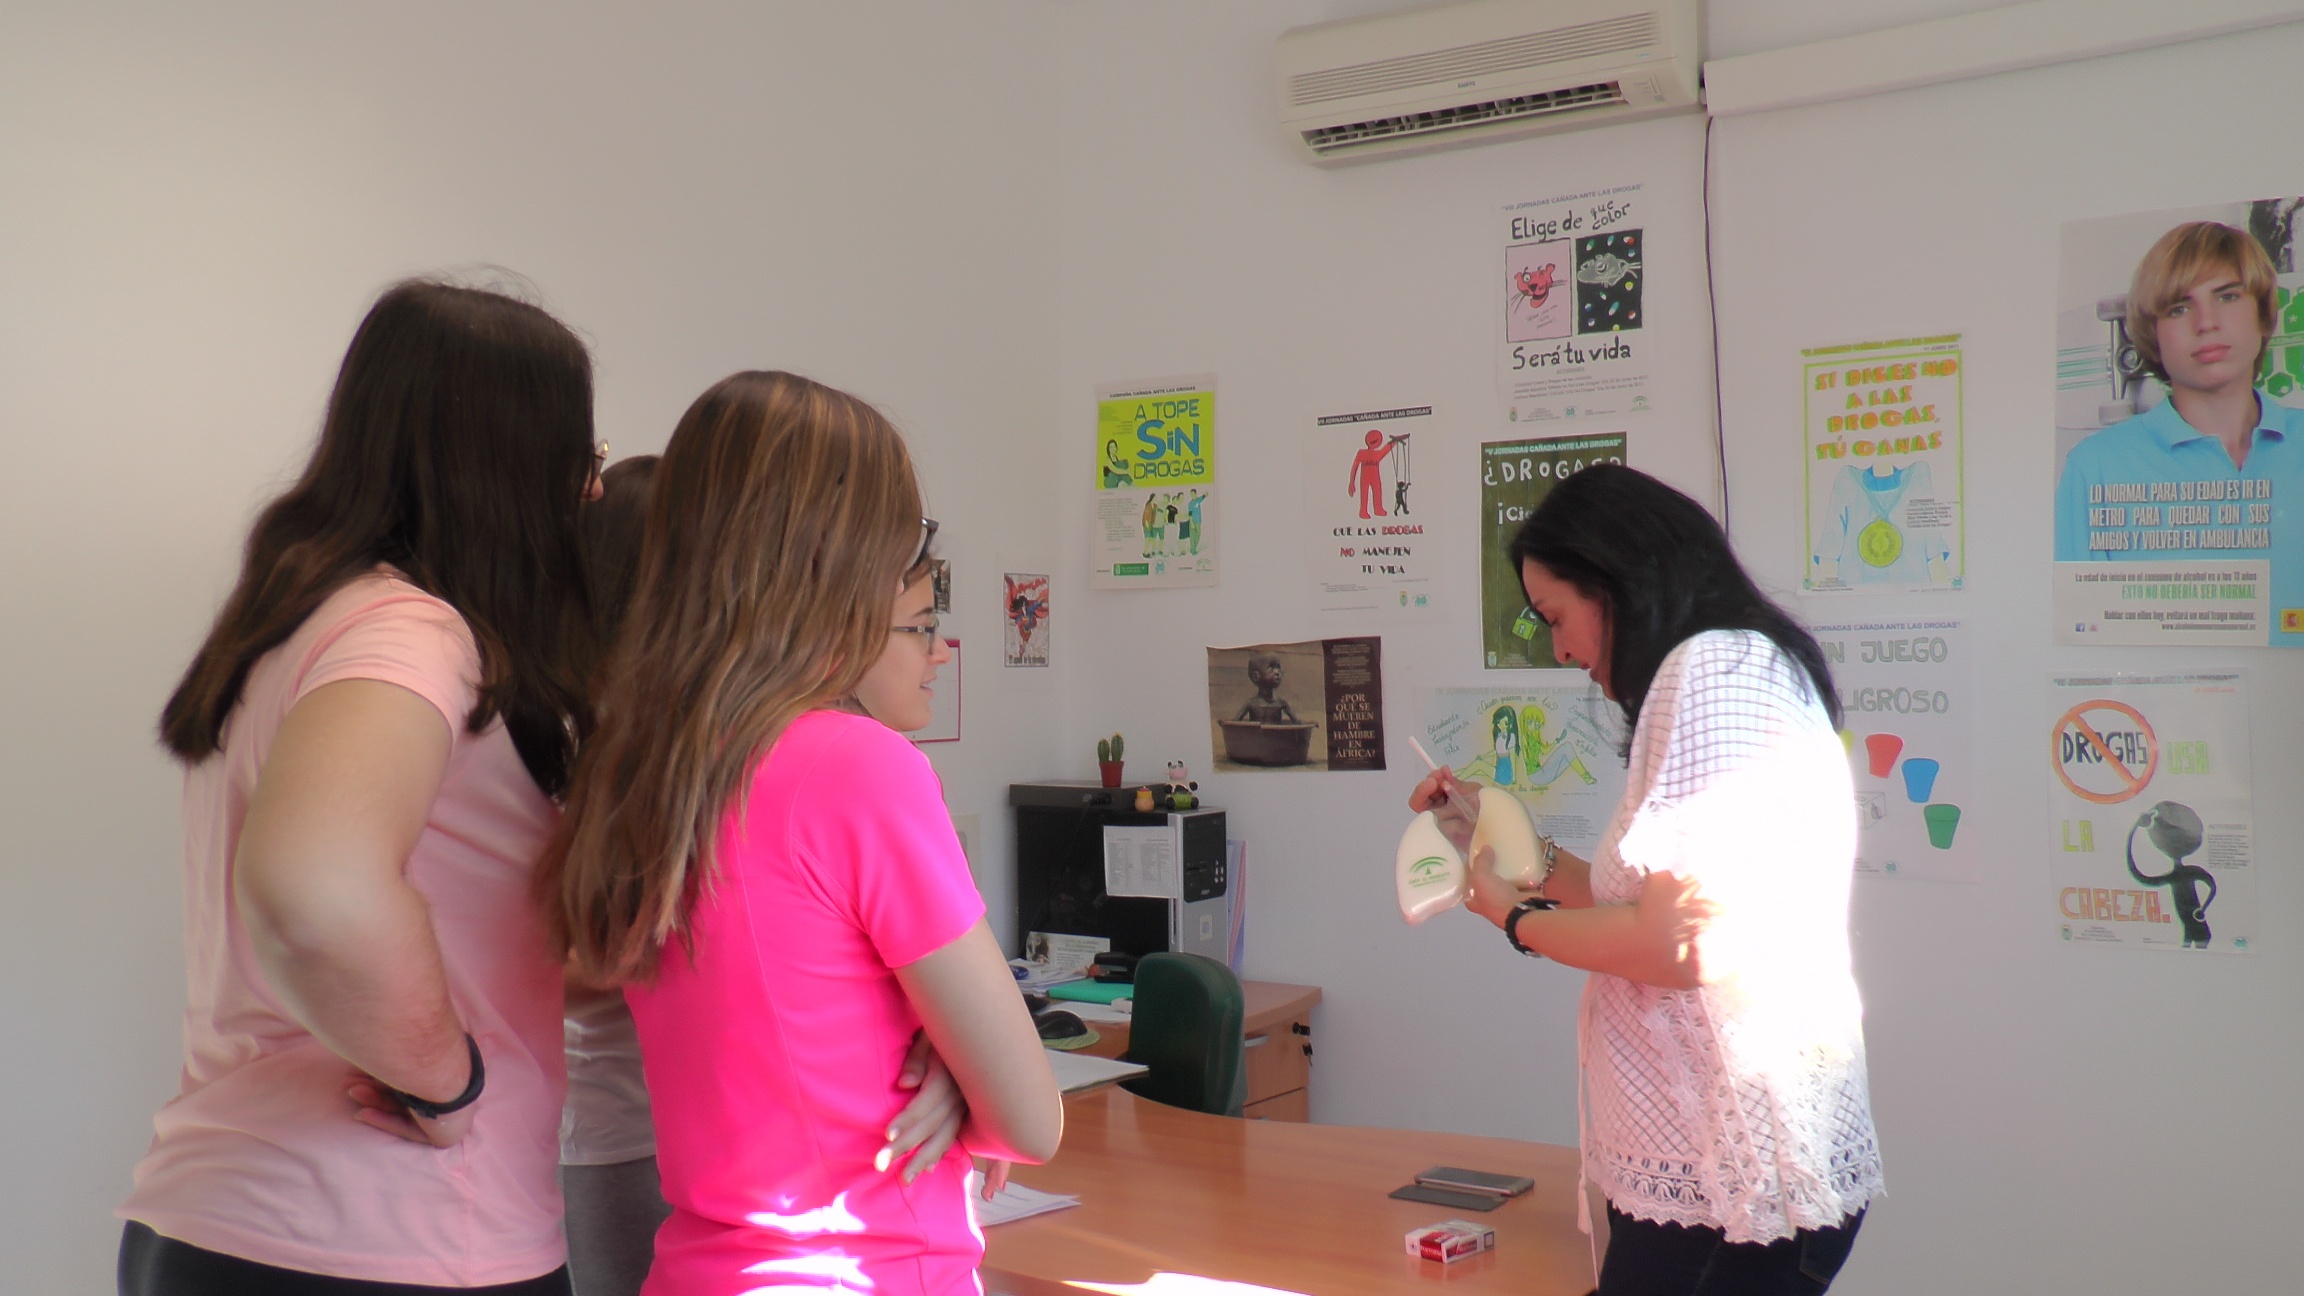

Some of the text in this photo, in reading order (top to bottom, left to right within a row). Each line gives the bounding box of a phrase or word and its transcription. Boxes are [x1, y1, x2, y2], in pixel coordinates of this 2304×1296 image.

[1515, 198, 1550, 210] JORNADAS
[1551, 194, 1578, 204] CAÑADA
[1578, 191, 1597, 199] ANTE
[1612, 184, 1644, 194] DROGAS"
[1590, 200, 1614, 220] que
[1592, 203, 1631, 231] color
[1511, 209, 1583, 243] Elige de
[1512, 335, 1631, 370] Será tu vida
[1845, 362, 1917, 387] DICES
[1920, 358, 1957, 377] NO
[1846, 385, 1913, 410] A LAS
[1134, 404, 1147, 421] A
[1152, 398, 1200, 420] TOPE
[1326, 416, 1354, 424] JORNADAS
[1354, 413, 1380, 421] "CAÑADA
[1826, 404, 1941, 433] DROGAS,
[1494, 447, 1529, 456] JORNADAS
[1529, 443, 1557, 453] CAÑADA
[1557, 442, 1574, 450] ANTE
[1576, 441, 1589, 449] LAS
[1590, 439, 1622, 448] DROGAS"
[1815, 431, 1942, 460] TÚ GANAS
[1133, 458, 1205, 479] DROGAS
[2090, 479, 2270, 503] LO NORMAL PARA SU EDAD ES IR EN
[2089, 504, 2270, 527] METRO PARA QUEDAR CON SUS
[1333, 524, 1424, 536] QUE LAS DROGAS
[2089, 528, 2270, 550] AMIGOS Y VOLVER EN AMBULANCIA
[1340, 546, 1411, 557] NO MANEJEN
[1362, 565, 1405, 574] TU VIDA
[2075, 573, 2082, 582] La
[2084, 573, 2099, 582] edad
[2100, 573, 2108, 582] de
[2128, 574, 2135, 582] en
[2137, 573, 2143, 581] el
[2145, 573, 2172, 581] consumo
[2174, 572, 2182, 581] de
[2184, 572, 2207, 581] alcohol
[2222, 573, 2231, 581] los
[2241, 572, 2257, 581] años
[2122, 584, 2143, 599] ESTO
[2146, 584, 2158, 599] NO
[2200, 583, 2217, 599] SER
[2219, 583, 2257, 599] NORMAL
[1854, 622, 1885, 631] CAÑADA
[1907, 622, 1922, 630] LAS
[1924, 621, 1960, 629] DROGAS"
[2104, 610, 2123, 620] Hablar
[2125, 612, 2136, 620] con
[2137, 610, 2152, 620] ellos
[2189, 611, 2197, 620] un
[2199, 610, 2210, 620] mal
[2211, 610, 2228, 622] trago
[1861, 636, 1948, 663] JUEGO
[1341, 694, 1365, 703] ¿POR
[1359, 702, 1370, 711] SE
[1836, 687, 1949, 714] LIGROSO
[1333, 712, 1374, 721] MUEREN
[1348, 721, 1360, 730] DE
[1333, 730, 1376, 740] HAMBRE
[1348, 740, 1361, 748] EN
[2061, 731, 2149, 764] DROGAS
[2167, 740, 2209, 774] USA
[2063, 820, 2094, 852] LA
[2060, 886, 2171, 923] CABEZA.
